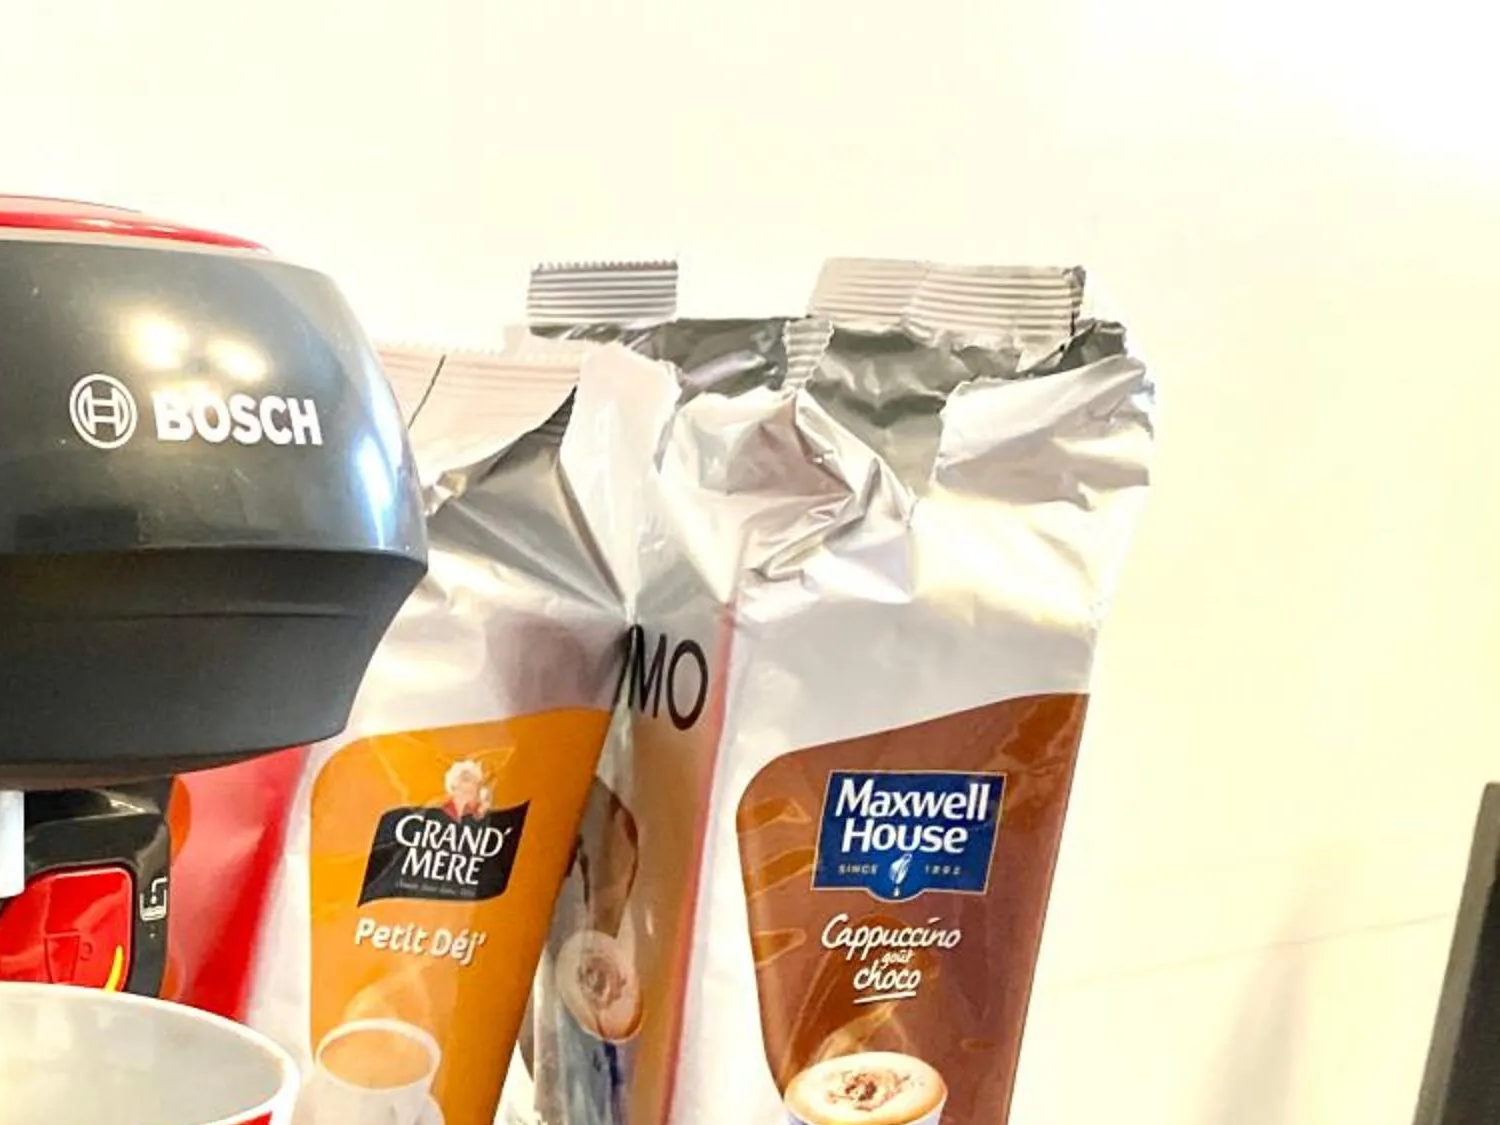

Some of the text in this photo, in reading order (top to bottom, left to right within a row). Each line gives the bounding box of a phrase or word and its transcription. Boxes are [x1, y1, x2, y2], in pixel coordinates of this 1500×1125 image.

[152, 388, 323, 446] BOSCH
[835, 778, 991, 821] Maxwell
[395, 814, 513, 858] GRAND'
[841, 818, 968, 854] House
[838, 864, 879, 876] SINCE
[355, 917, 425, 954] Petit
[821, 913, 962, 961] Cappuccino
[853, 960, 922, 991] choco
